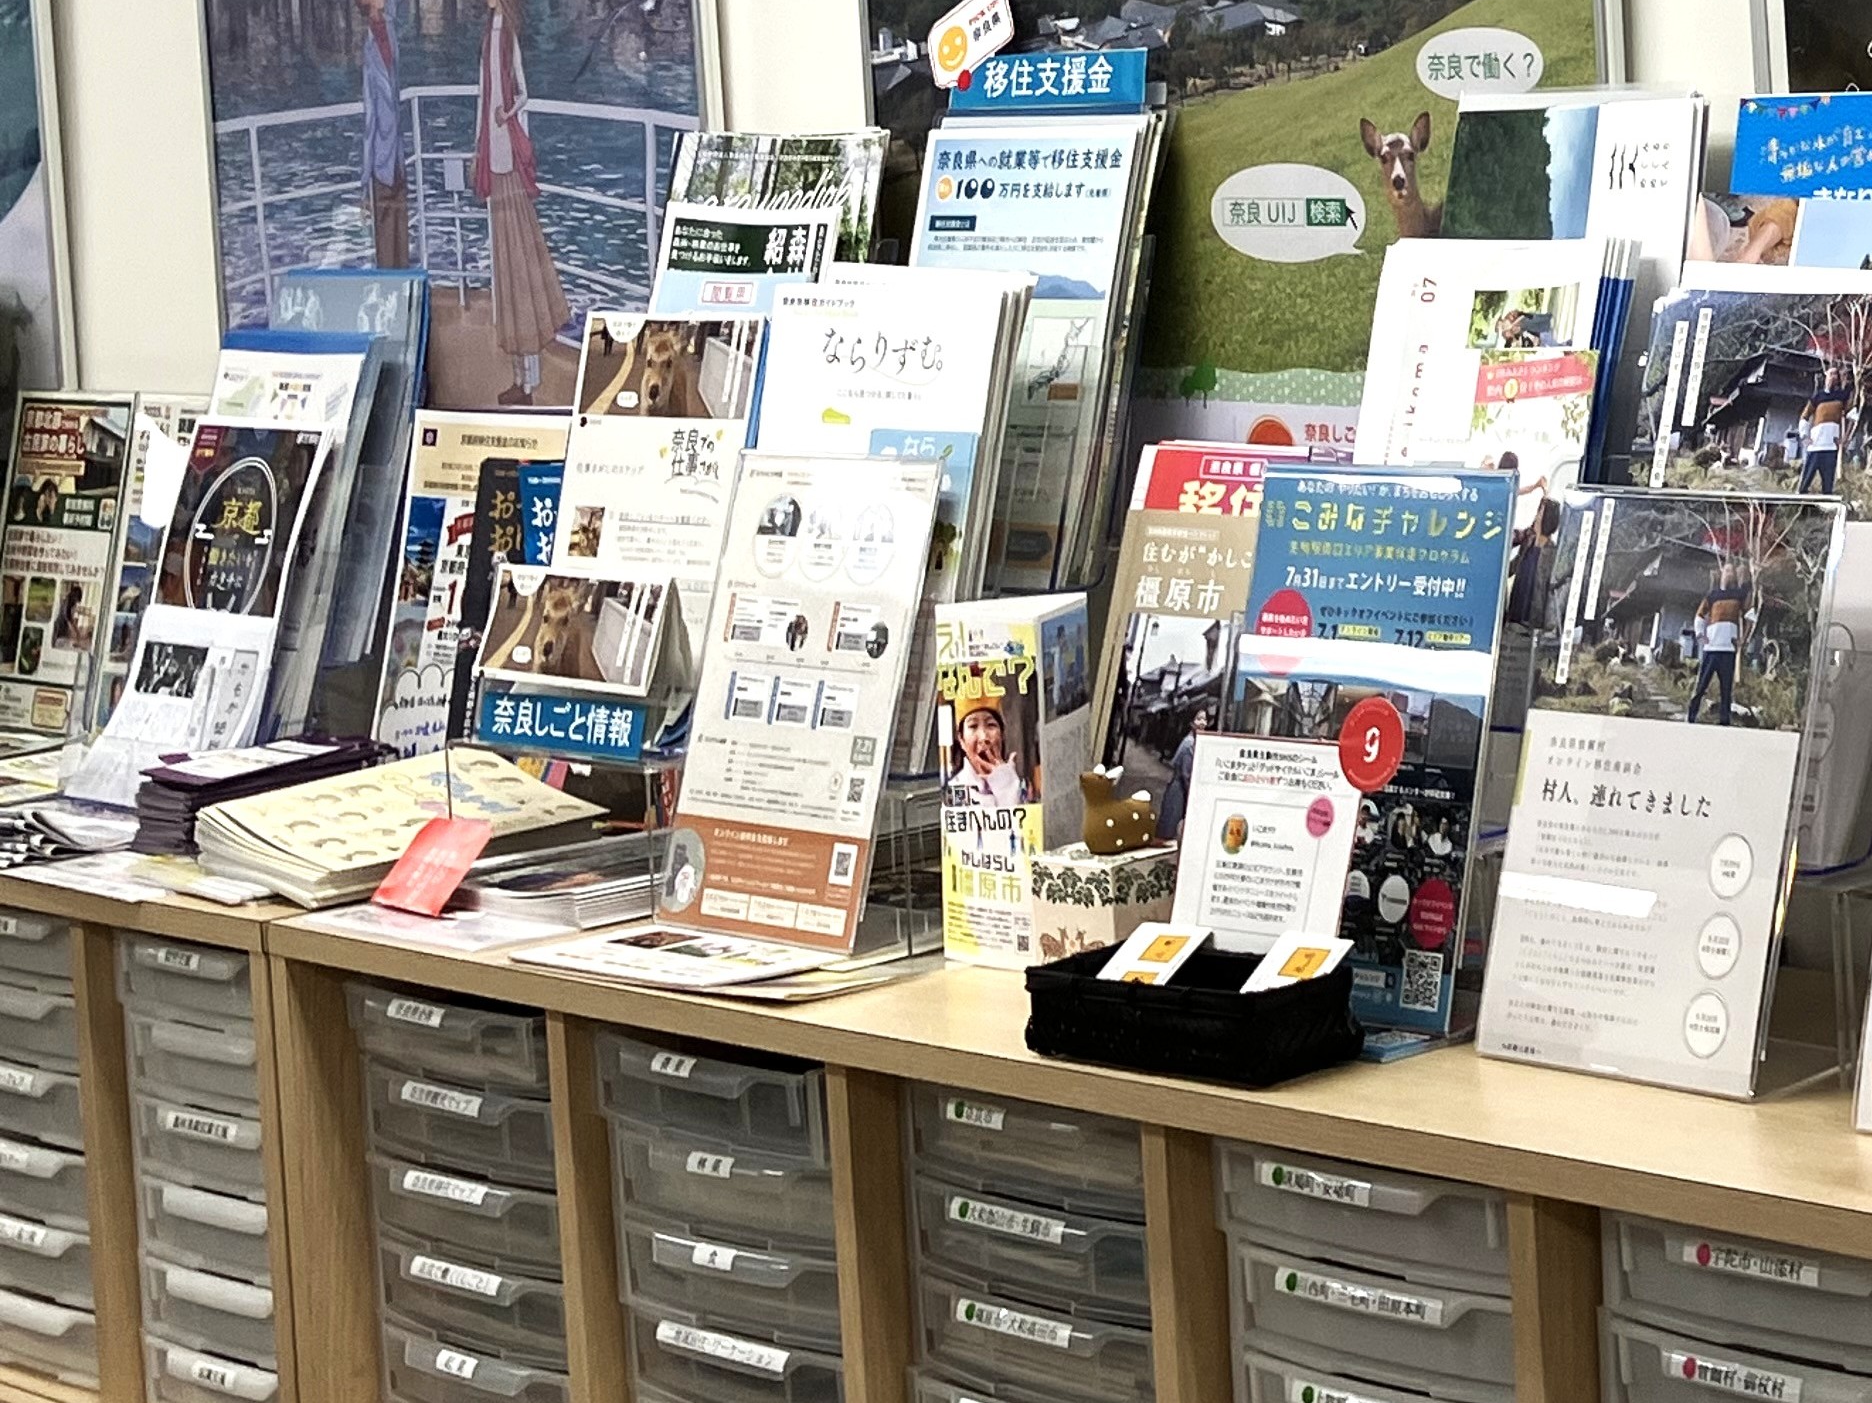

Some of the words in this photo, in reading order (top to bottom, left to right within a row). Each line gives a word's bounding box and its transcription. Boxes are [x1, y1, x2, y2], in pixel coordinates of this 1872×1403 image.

[983, 55, 1114, 99] 移住支援金
[1228, 199, 1262, 226] 奈良
[1268, 200, 1296, 226] UIJ
[1309, 198, 1343, 226] 検索
[212, 498, 263, 536] 京都
[1134, 576, 1226, 615] 橿原市
[492, 697, 633, 747] 奈良しごと情報
[1363, 726, 1381, 764] 9
[1542, 777, 1711, 818] 村人、連れてきました
